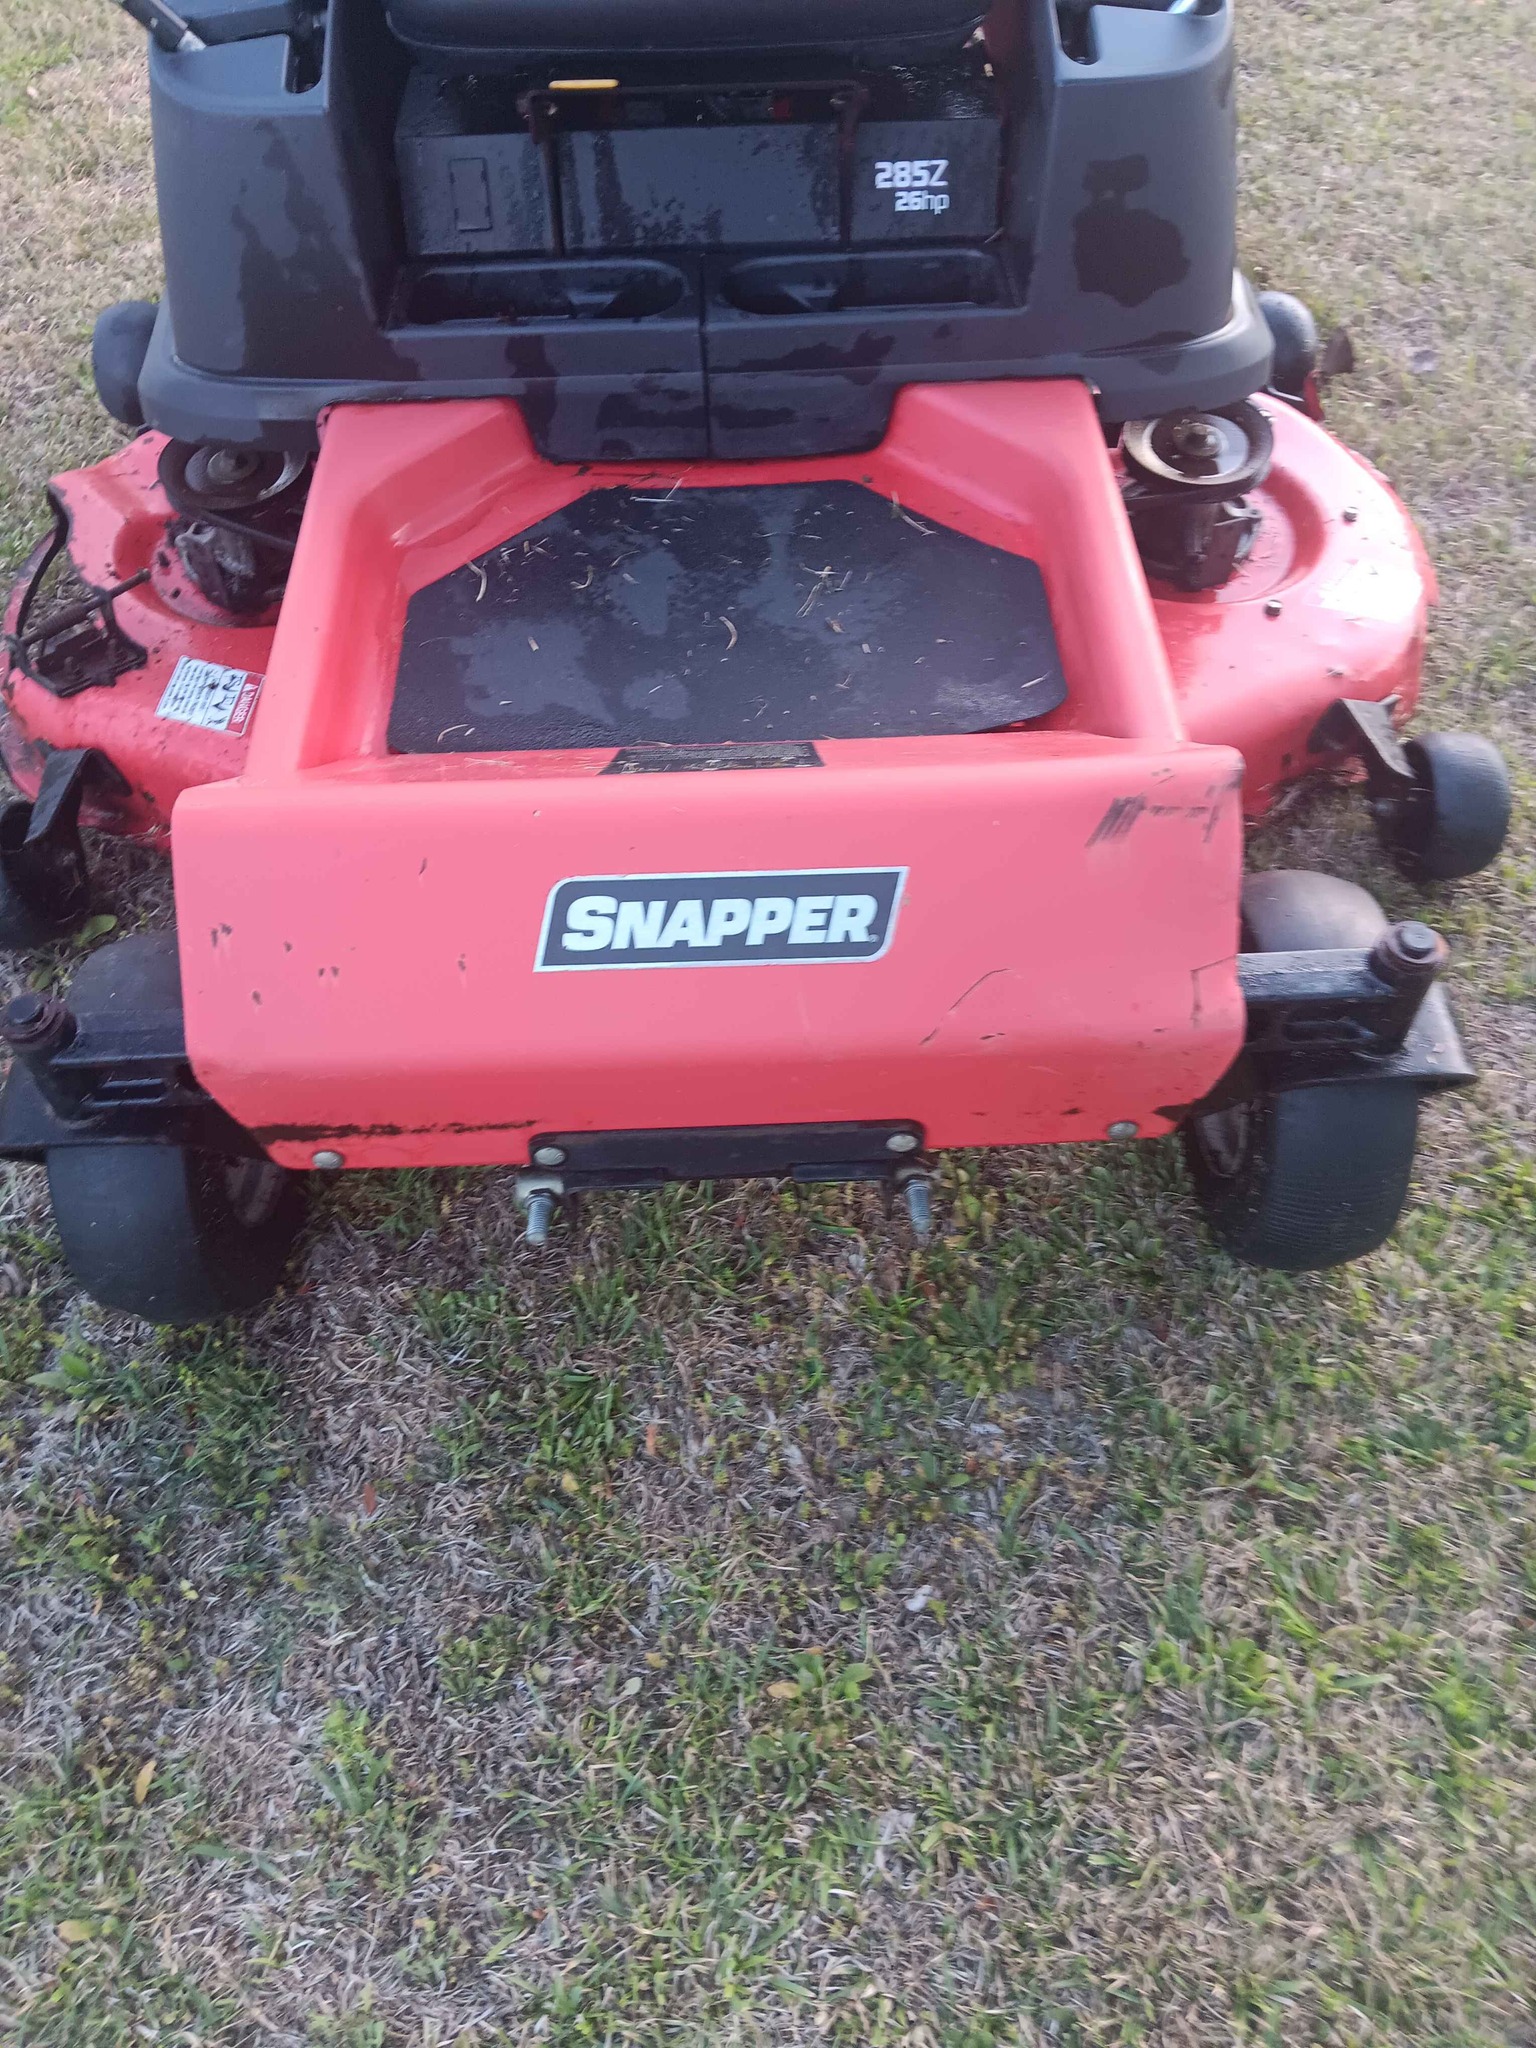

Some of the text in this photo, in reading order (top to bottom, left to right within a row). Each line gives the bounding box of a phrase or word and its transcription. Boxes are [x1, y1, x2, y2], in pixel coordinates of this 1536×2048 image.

[875, 159, 949, 188] 285Z
[895, 190, 950, 215] 26hp
[561, 894, 879, 952] SNAPPER
